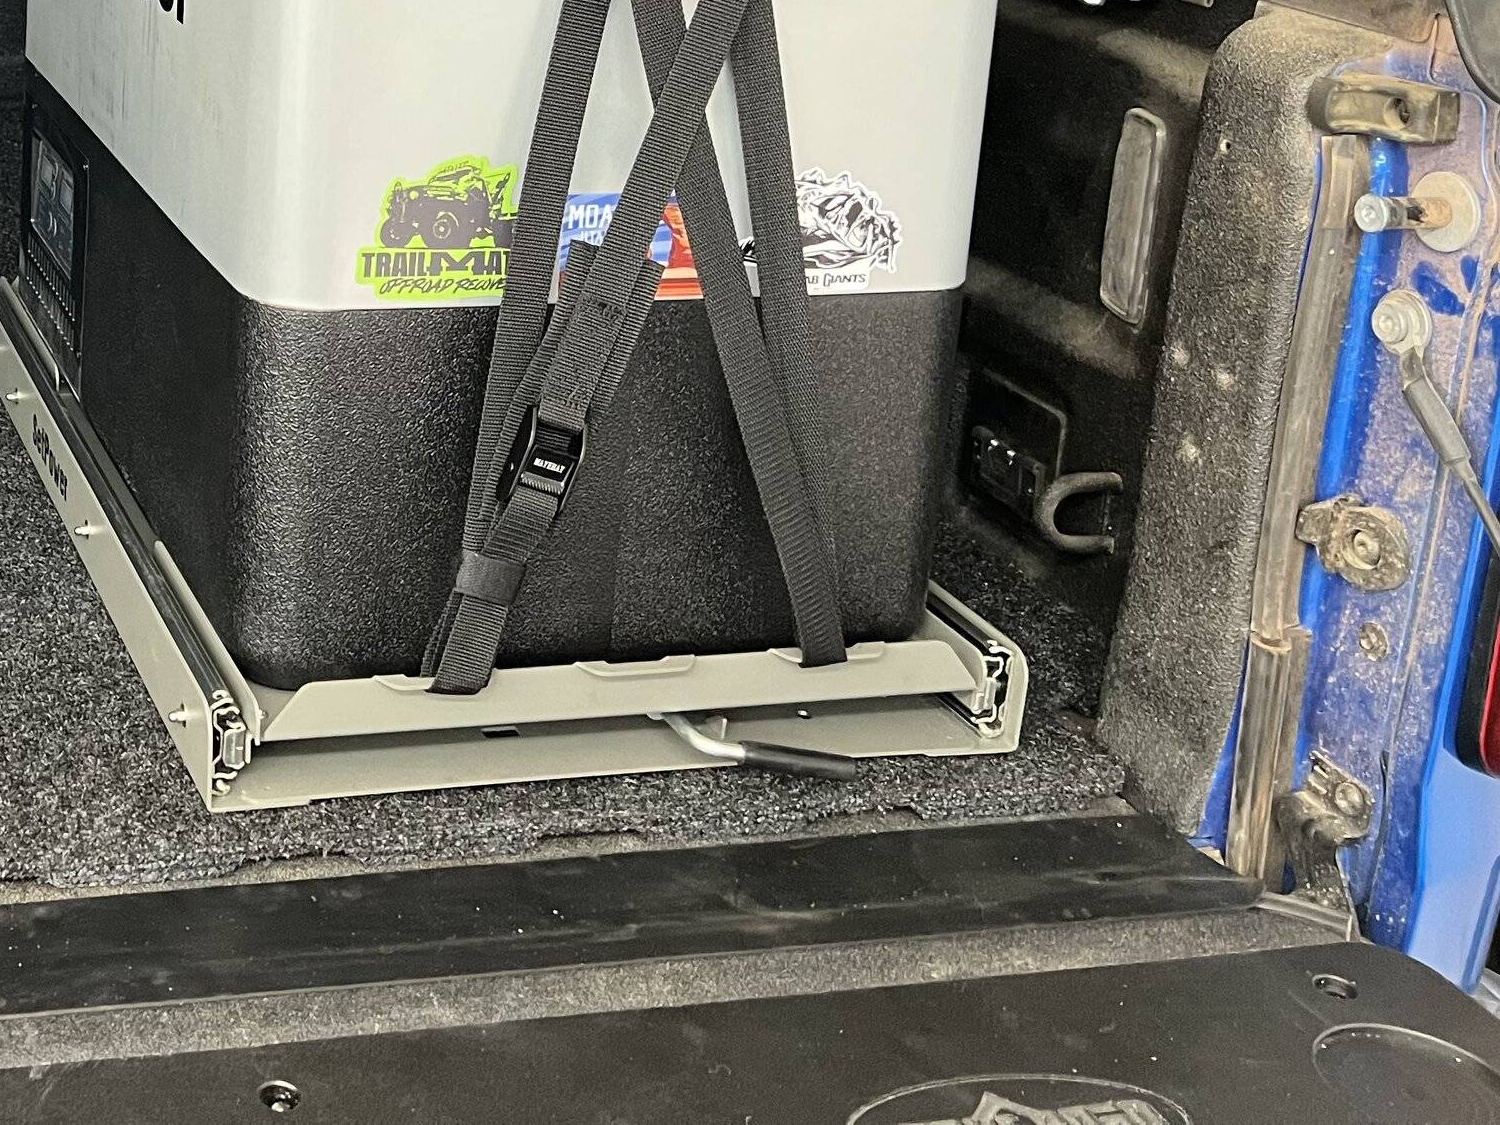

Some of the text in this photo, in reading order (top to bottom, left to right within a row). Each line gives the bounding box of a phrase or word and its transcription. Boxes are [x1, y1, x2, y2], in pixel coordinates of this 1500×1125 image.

[567, 204, 613, 231] MOA
[426, 250, 511, 277] MAT
[379, 277, 507, 295] OFFROAD RECOVE
[822, 273, 867, 287] GIANTS
